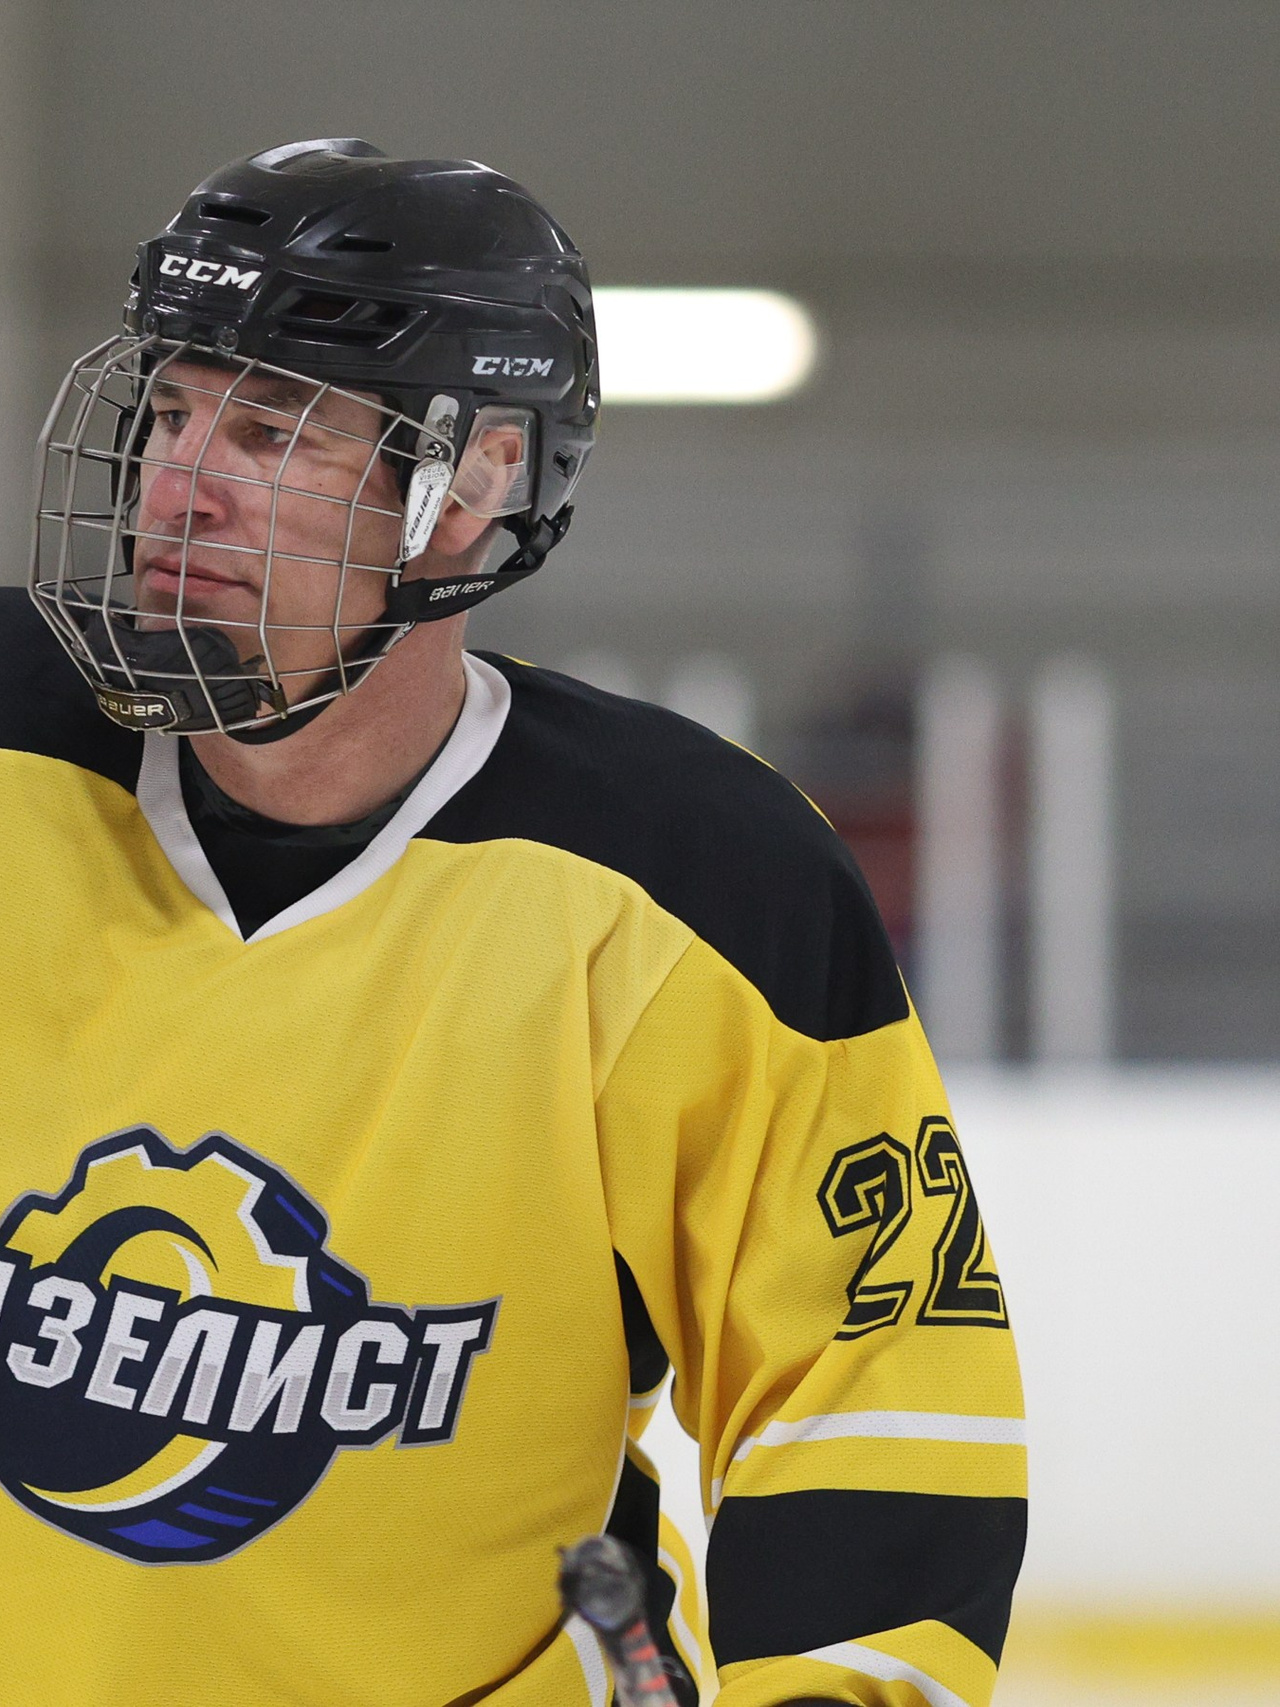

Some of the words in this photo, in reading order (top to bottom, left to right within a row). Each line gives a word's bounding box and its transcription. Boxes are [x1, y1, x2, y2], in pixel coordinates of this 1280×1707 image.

[160, 254, 262, 290] CCM
[472, 355, 554, 377] CCM
[409, 484, 433, 540] BAUER
[429, 580, 495, 602] BAUER
[99, 694, 164, 716] BAUER
[815, 1115, 1010, 1341] 22
